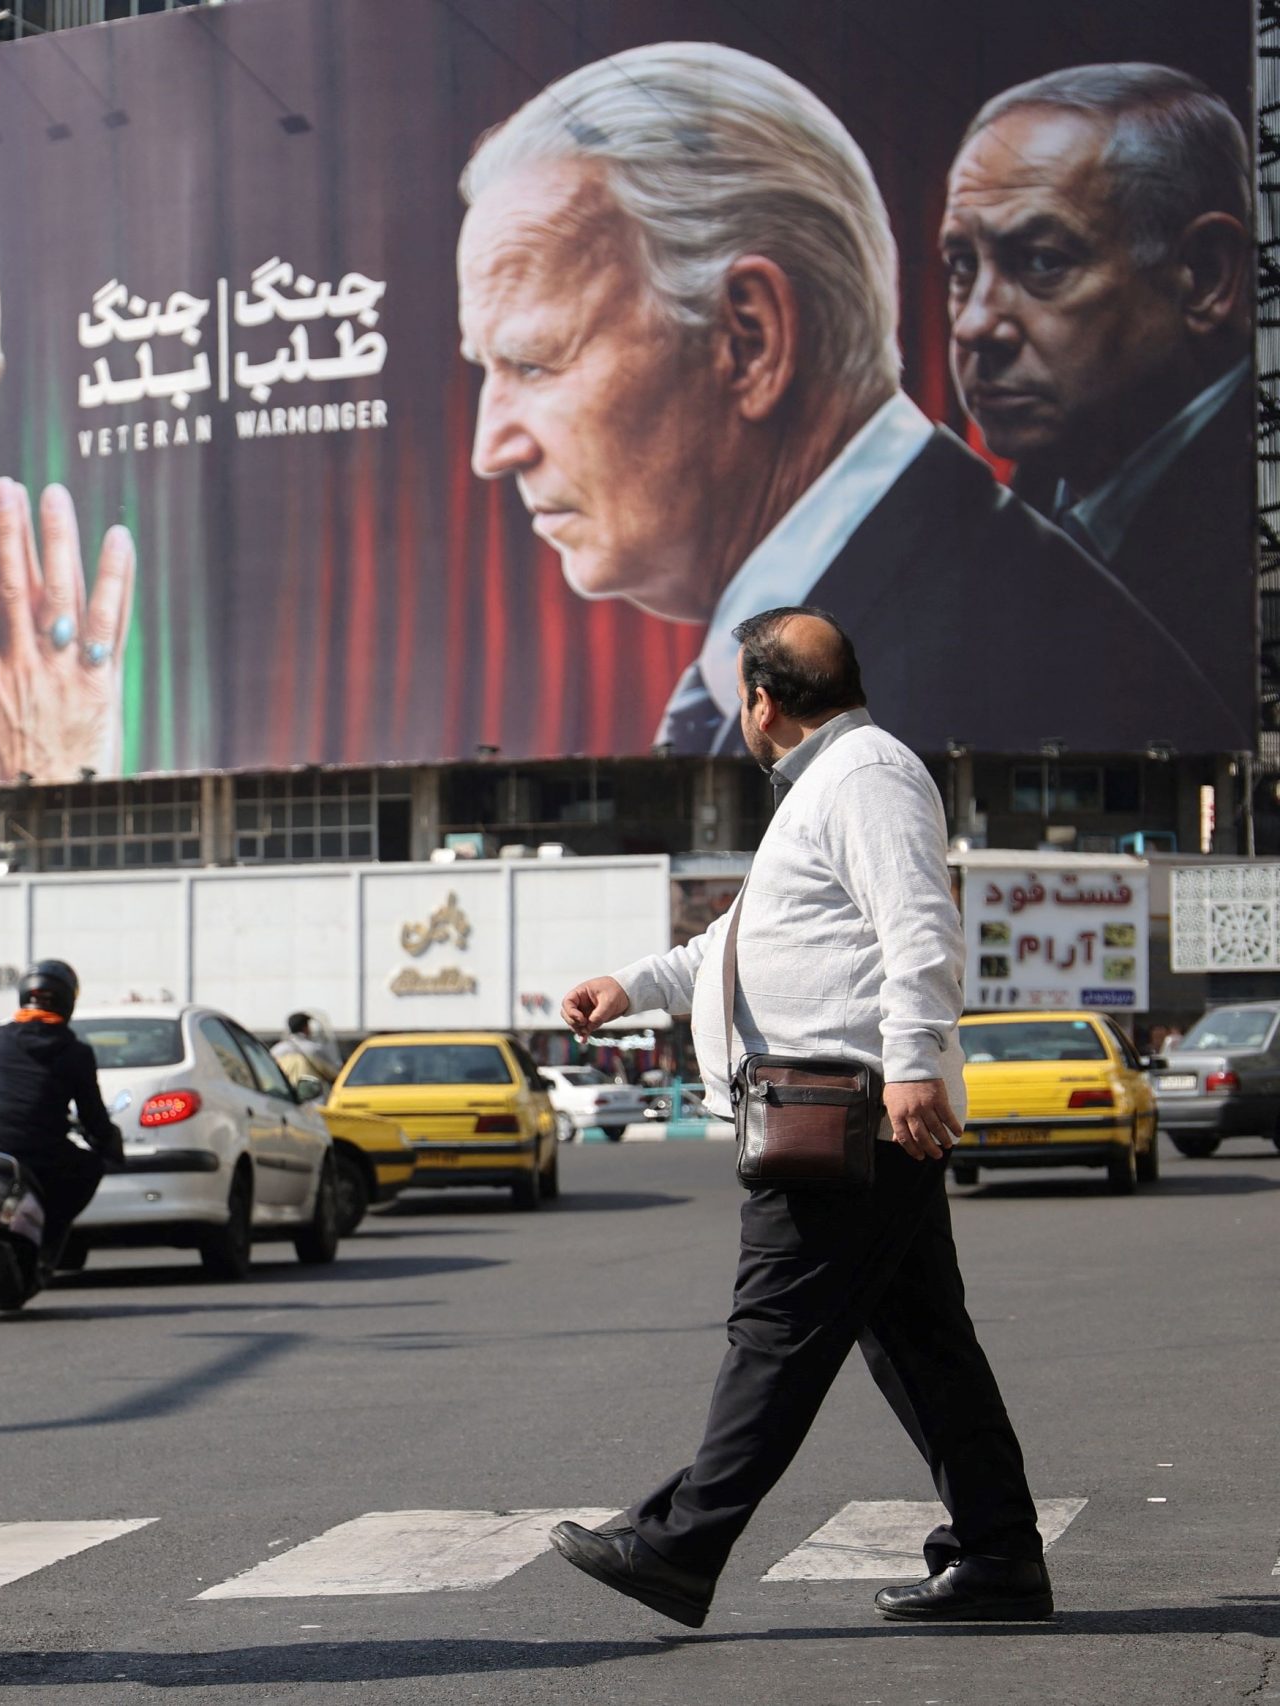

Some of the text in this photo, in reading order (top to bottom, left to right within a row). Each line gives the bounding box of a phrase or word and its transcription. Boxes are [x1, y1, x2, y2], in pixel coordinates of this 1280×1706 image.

[78, 278, 211, 347] جنگ
[234, 257, 386, 327] جنگ
[78, 342, 211, 410] بلد
[234, 320, 388, 402] طلب
[77, 414, 212, 457] VETERAN
[235, 399, 388, 438] WARMONGER
[984, 871, 1134, 914] فست فود
[1016, 930, 1098, 969] آرام
